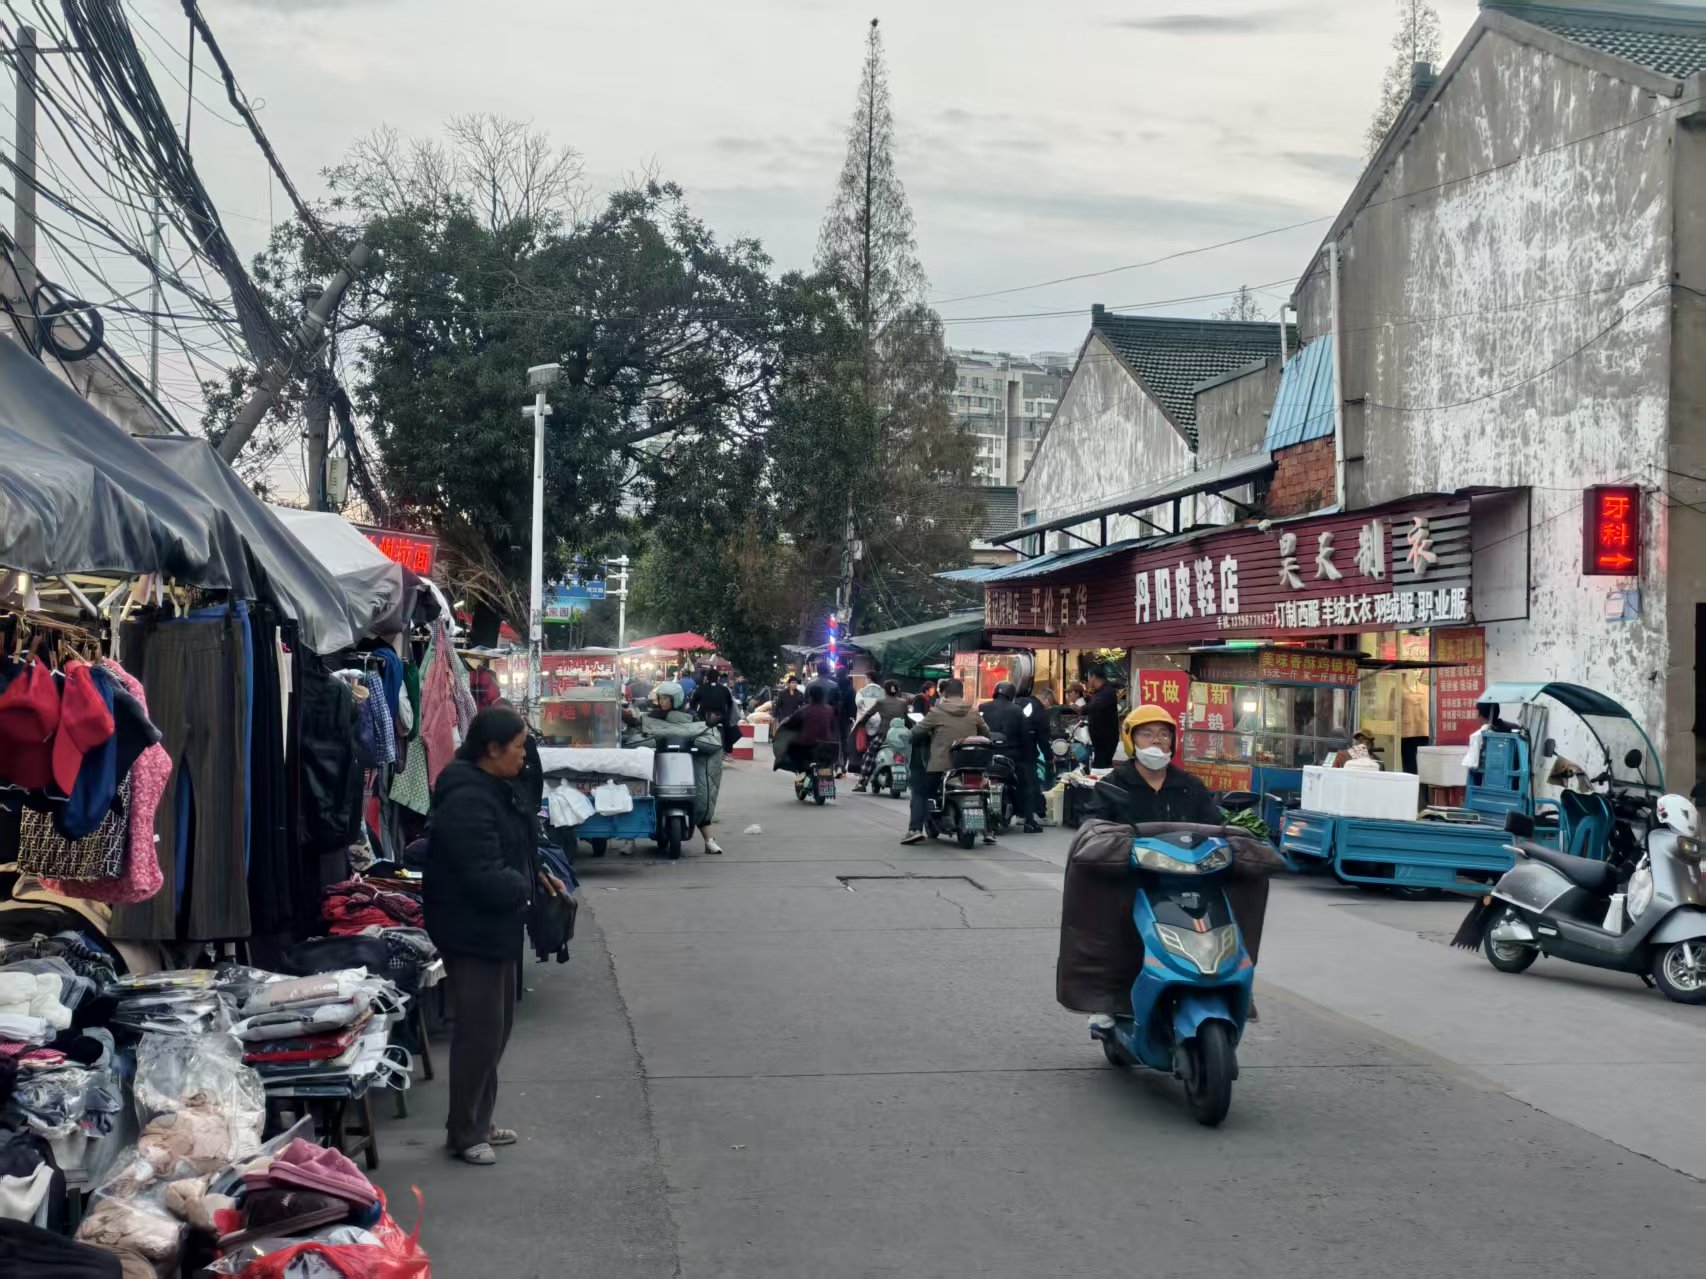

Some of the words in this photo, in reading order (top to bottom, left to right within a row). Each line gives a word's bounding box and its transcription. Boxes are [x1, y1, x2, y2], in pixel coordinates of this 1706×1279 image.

[1602, 496, 1630, 546] 牙科
[365, 535, 434, 575] 州拉面
[1135, 555, 1240, 624] 丹阳皮鞋店
[1274, 598, 1320, 629] 订制西服
[1322, 594, 1371, 627] 羊绒大衣
[1374, 591, 1414, 624] 羽绒服
[1417, 588, 1467, 622] 职业服
[1142, 680, 1180, 703] 订做
